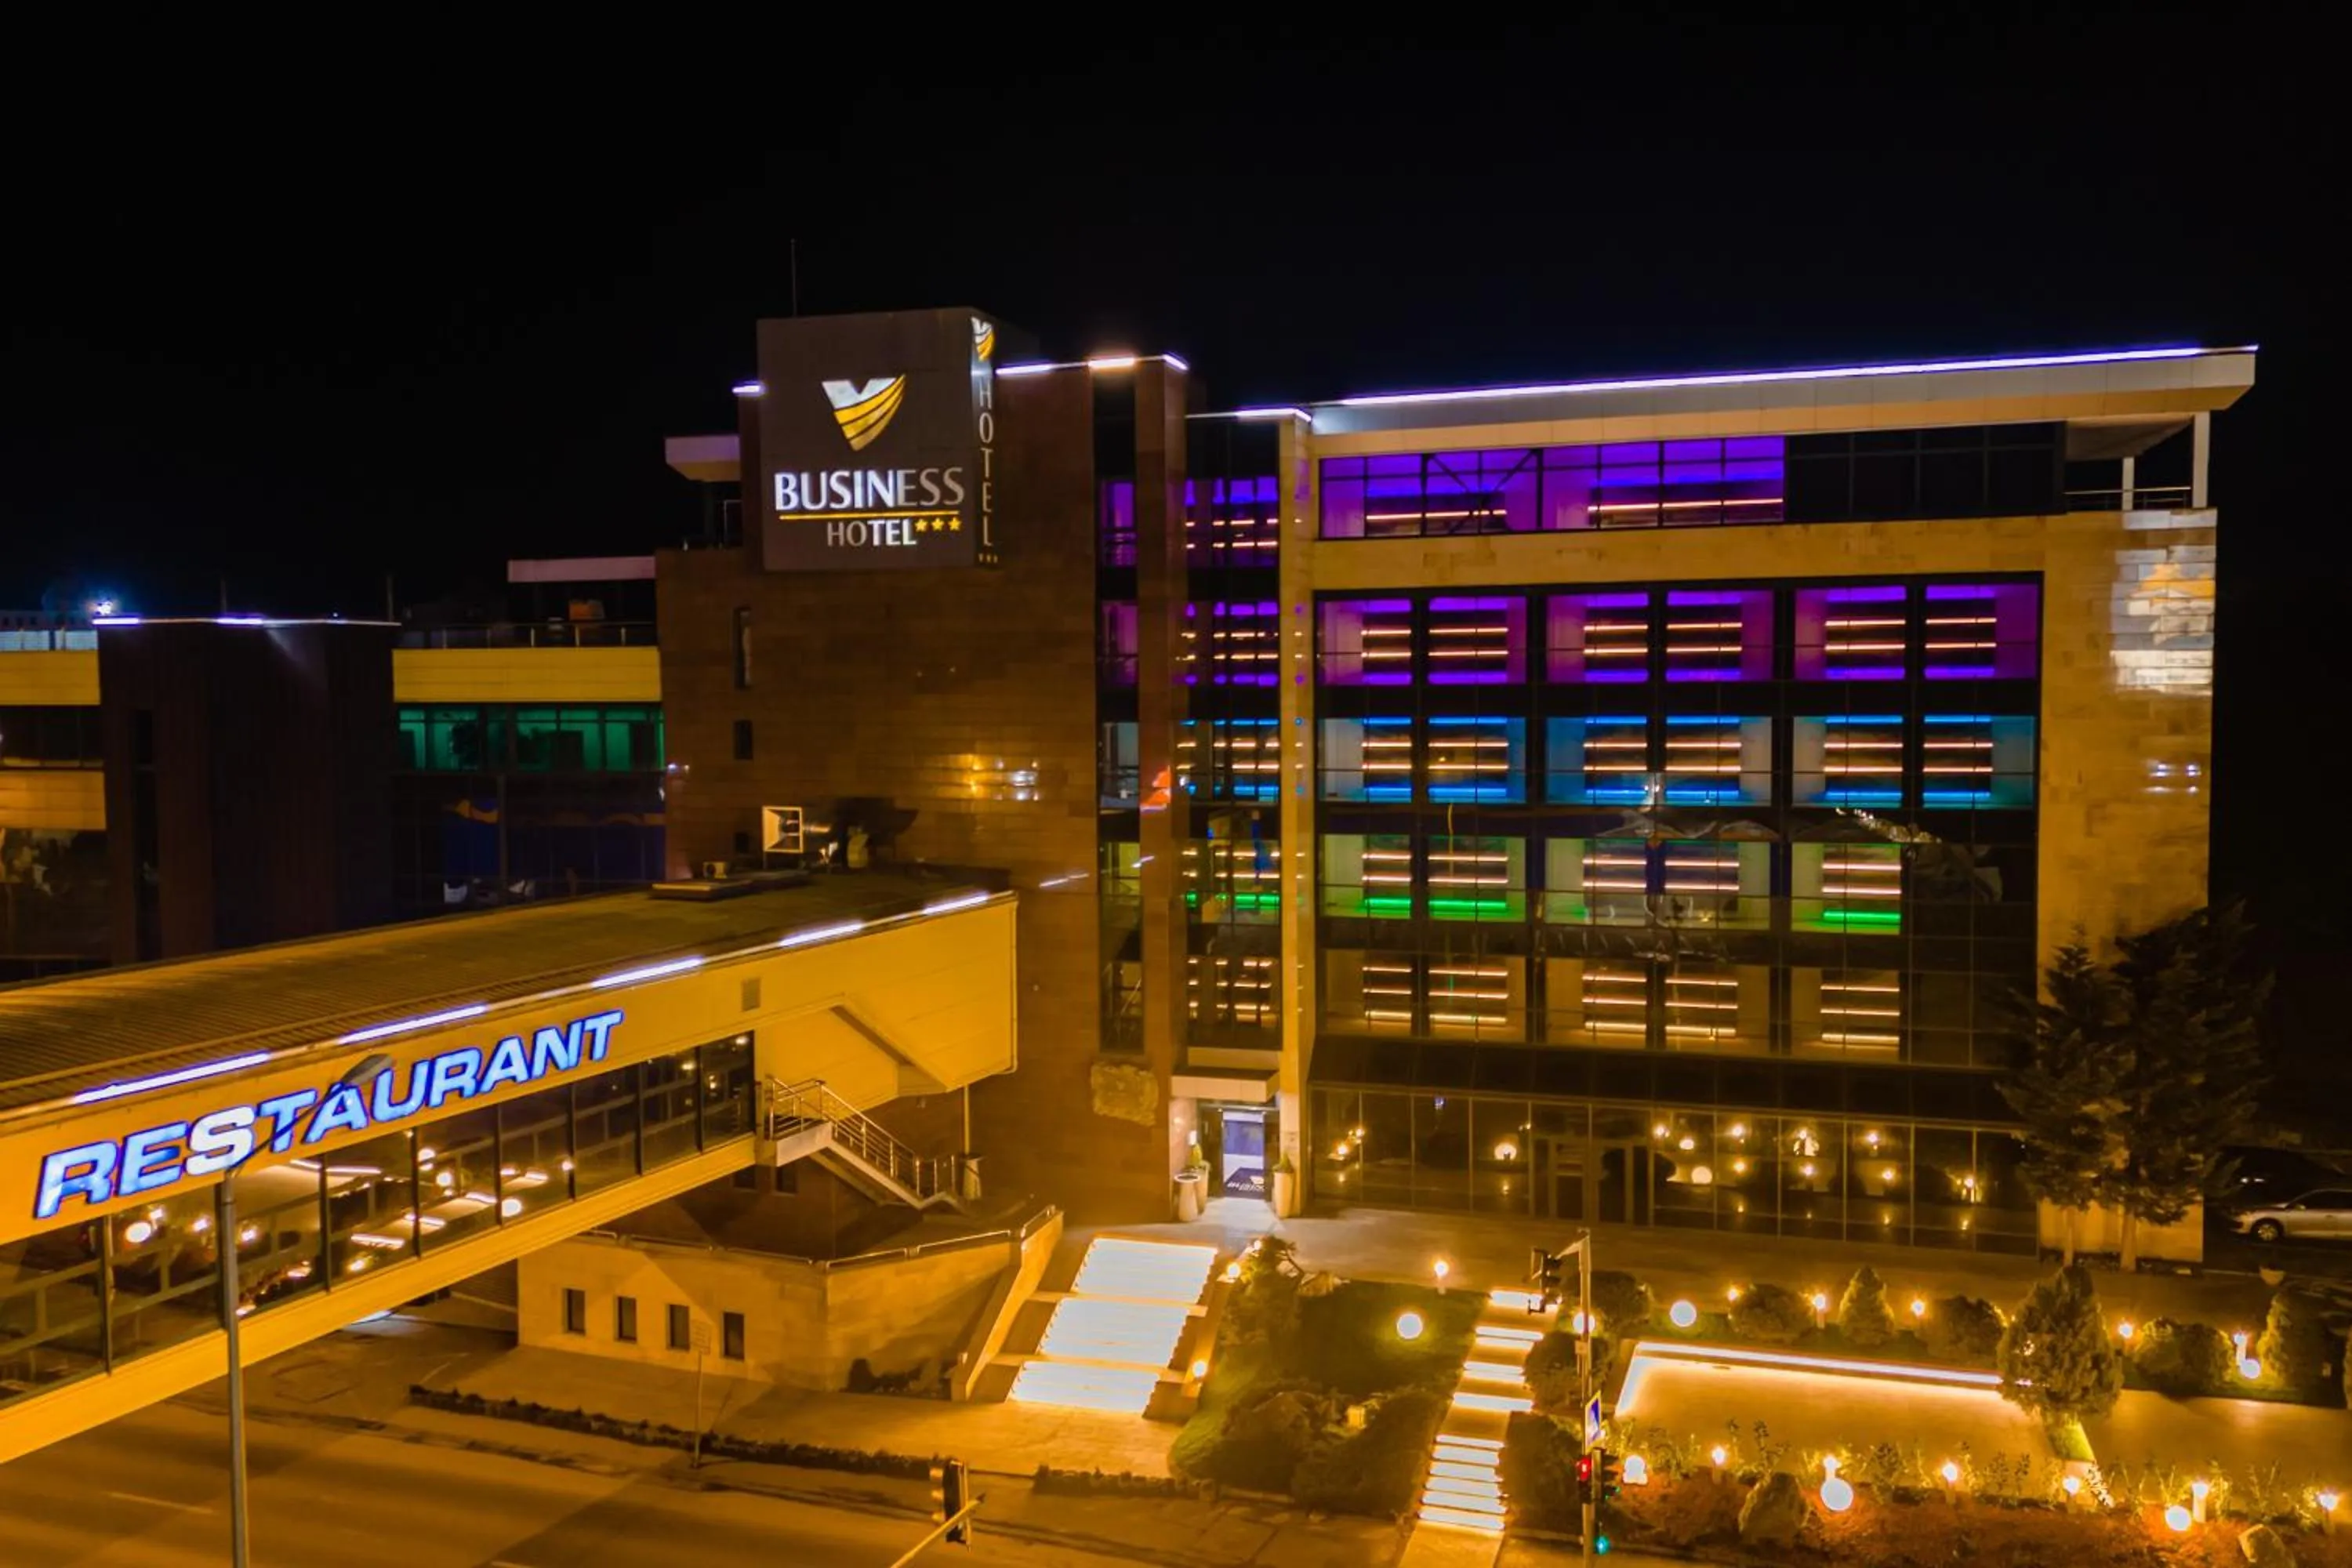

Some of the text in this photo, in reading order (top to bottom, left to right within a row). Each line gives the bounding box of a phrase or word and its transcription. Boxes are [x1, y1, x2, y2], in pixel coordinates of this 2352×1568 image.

[773, 467, 965, 510] BUSINESS
[979, 378, 993, 546] HOTEL
[826, 519, 917, 546] HOTEL
[34, 1010, 624, 1220] RESTAURANT
